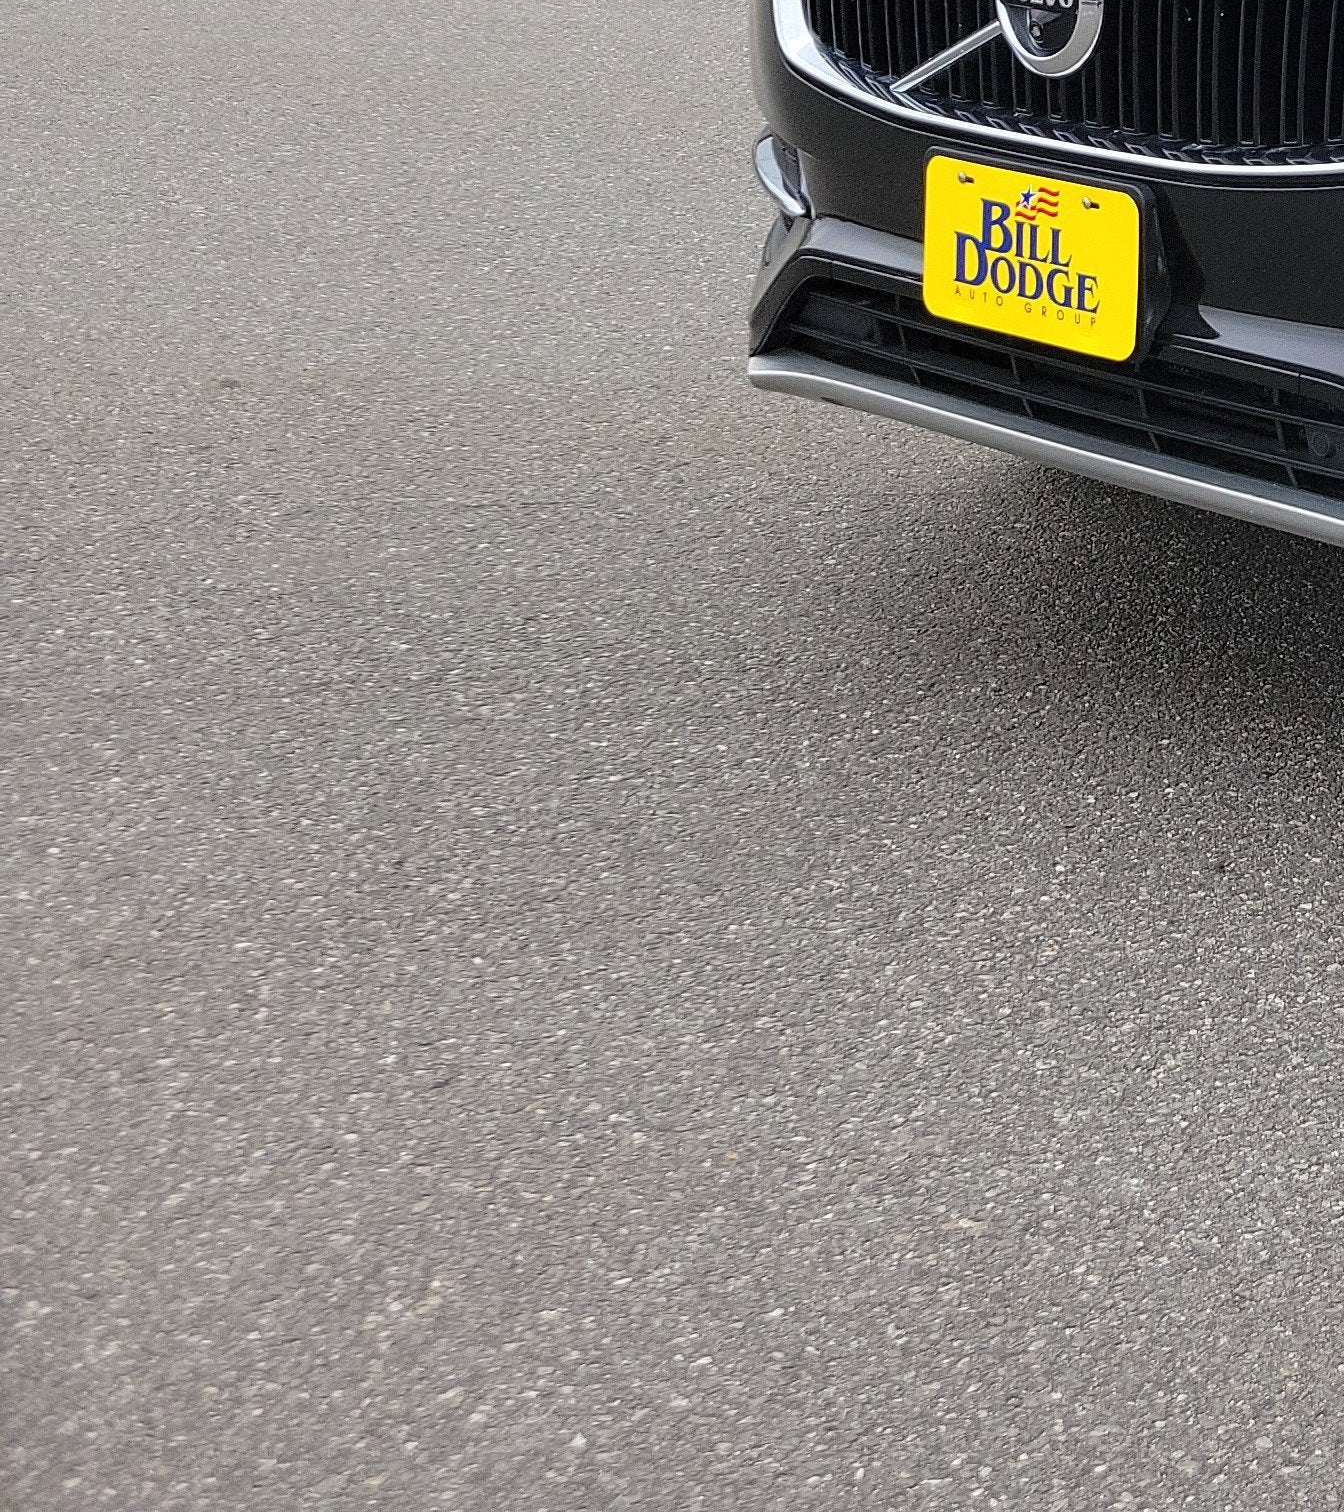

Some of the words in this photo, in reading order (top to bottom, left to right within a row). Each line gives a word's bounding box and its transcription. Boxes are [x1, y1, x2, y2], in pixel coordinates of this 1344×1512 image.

[980, 197, 1073, 268] BILL
[953, 230, 1101, 315] DODGE
[954, 285, 1004, 307] AUTO
[1024, 302, 1097, 328] GROUP
